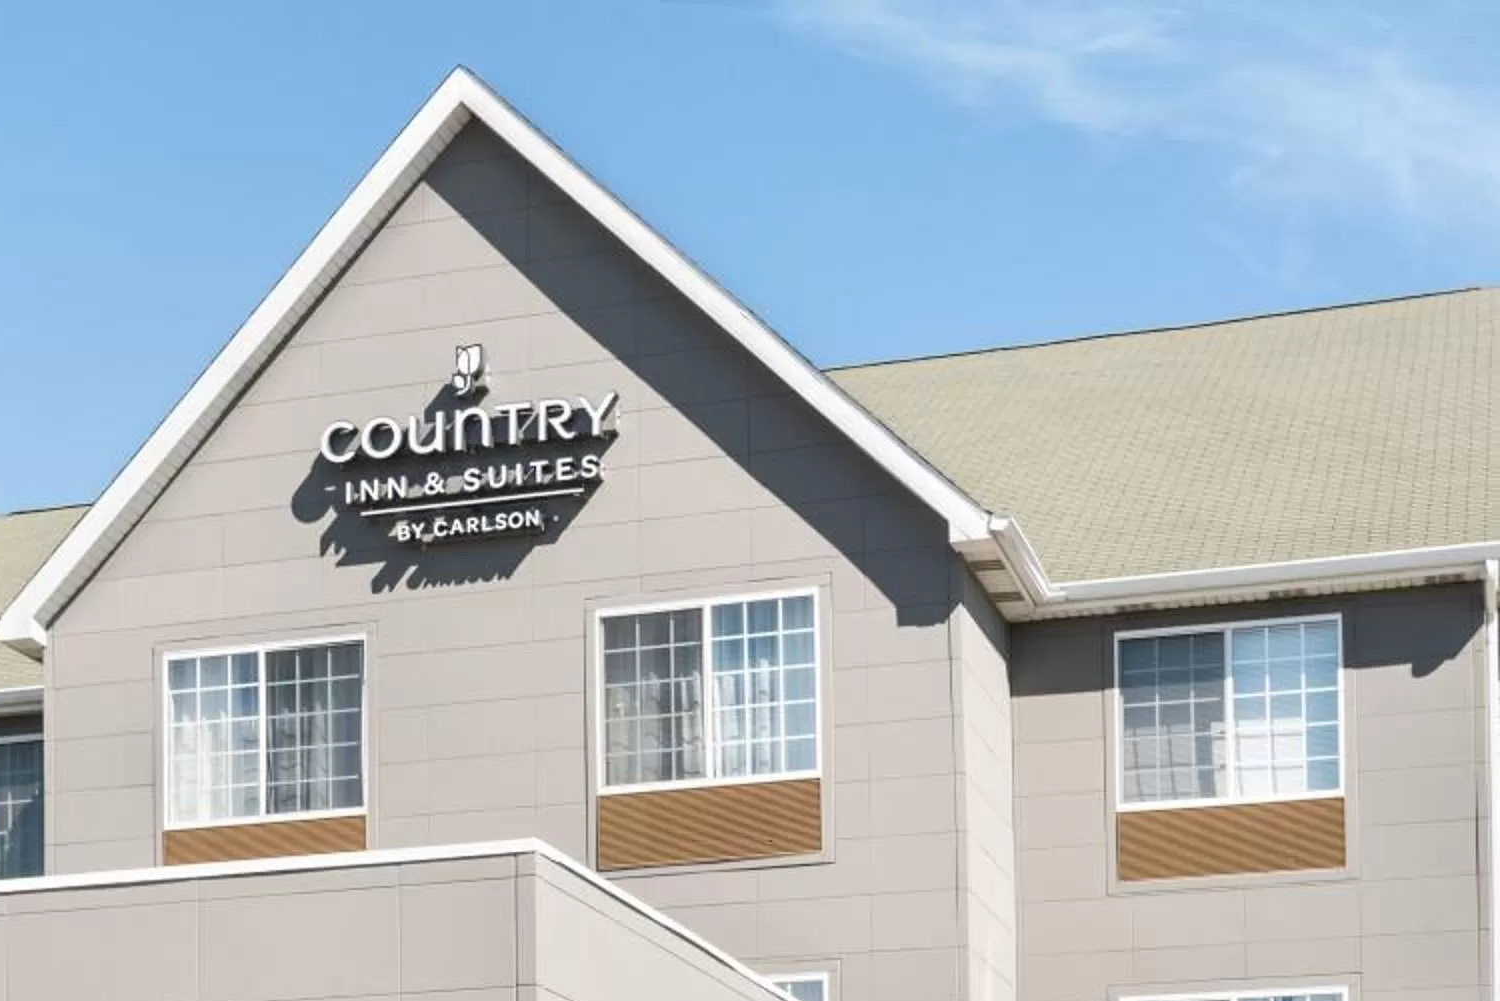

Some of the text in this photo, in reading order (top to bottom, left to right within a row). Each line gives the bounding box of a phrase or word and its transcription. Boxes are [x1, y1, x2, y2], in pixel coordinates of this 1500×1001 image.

[345, 455, 601, 504] INN & SUITES
[396, 509, 542, 542] BY CARLSON
